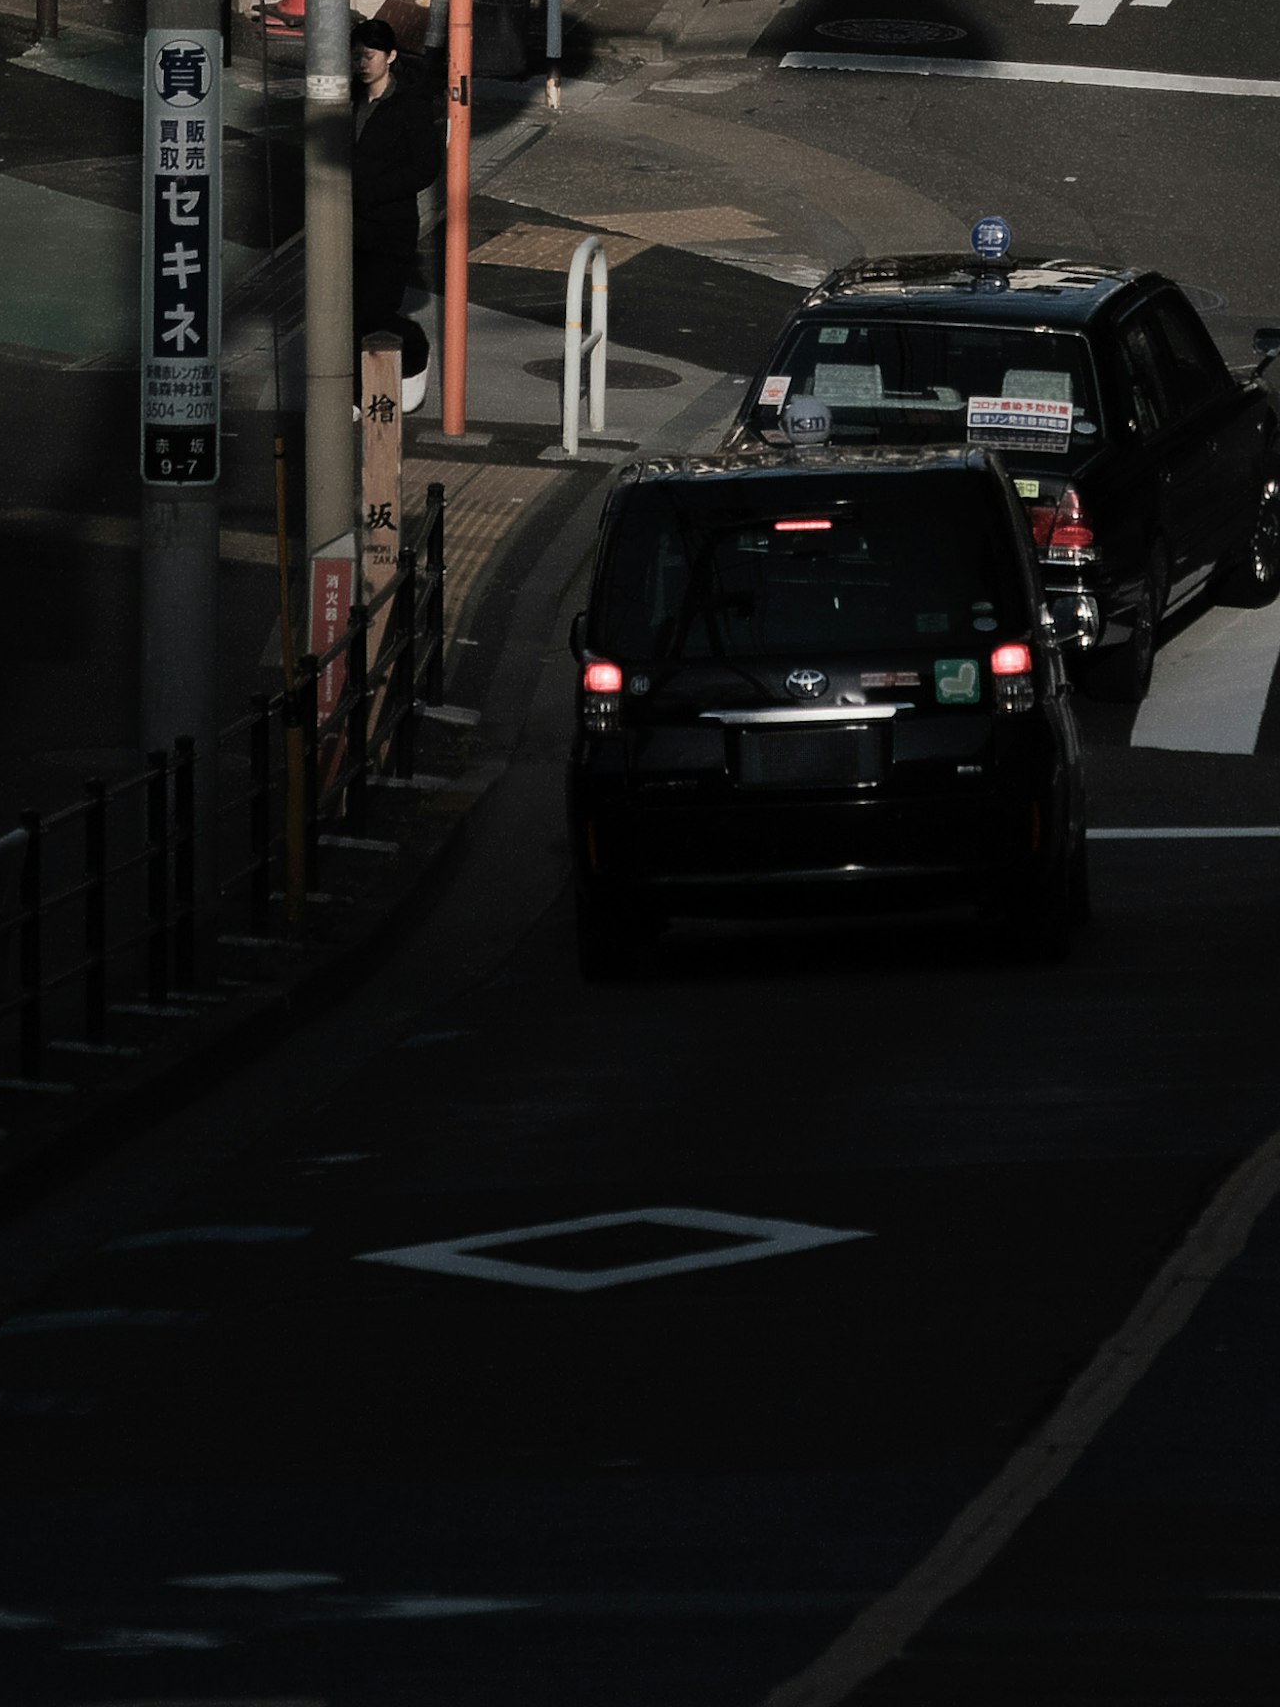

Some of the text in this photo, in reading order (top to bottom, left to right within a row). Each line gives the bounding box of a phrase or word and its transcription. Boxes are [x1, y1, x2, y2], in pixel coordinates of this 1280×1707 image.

[159, 47, 207, 102] 質
[161, 181, 202, 352] セキネ
[155, 437, 205, 454] 赤坂
[160, 458, 198, 475] 9-7
[367, 393, 398, 531] 檜坂
[325, 574, 339, 621] 消火器
